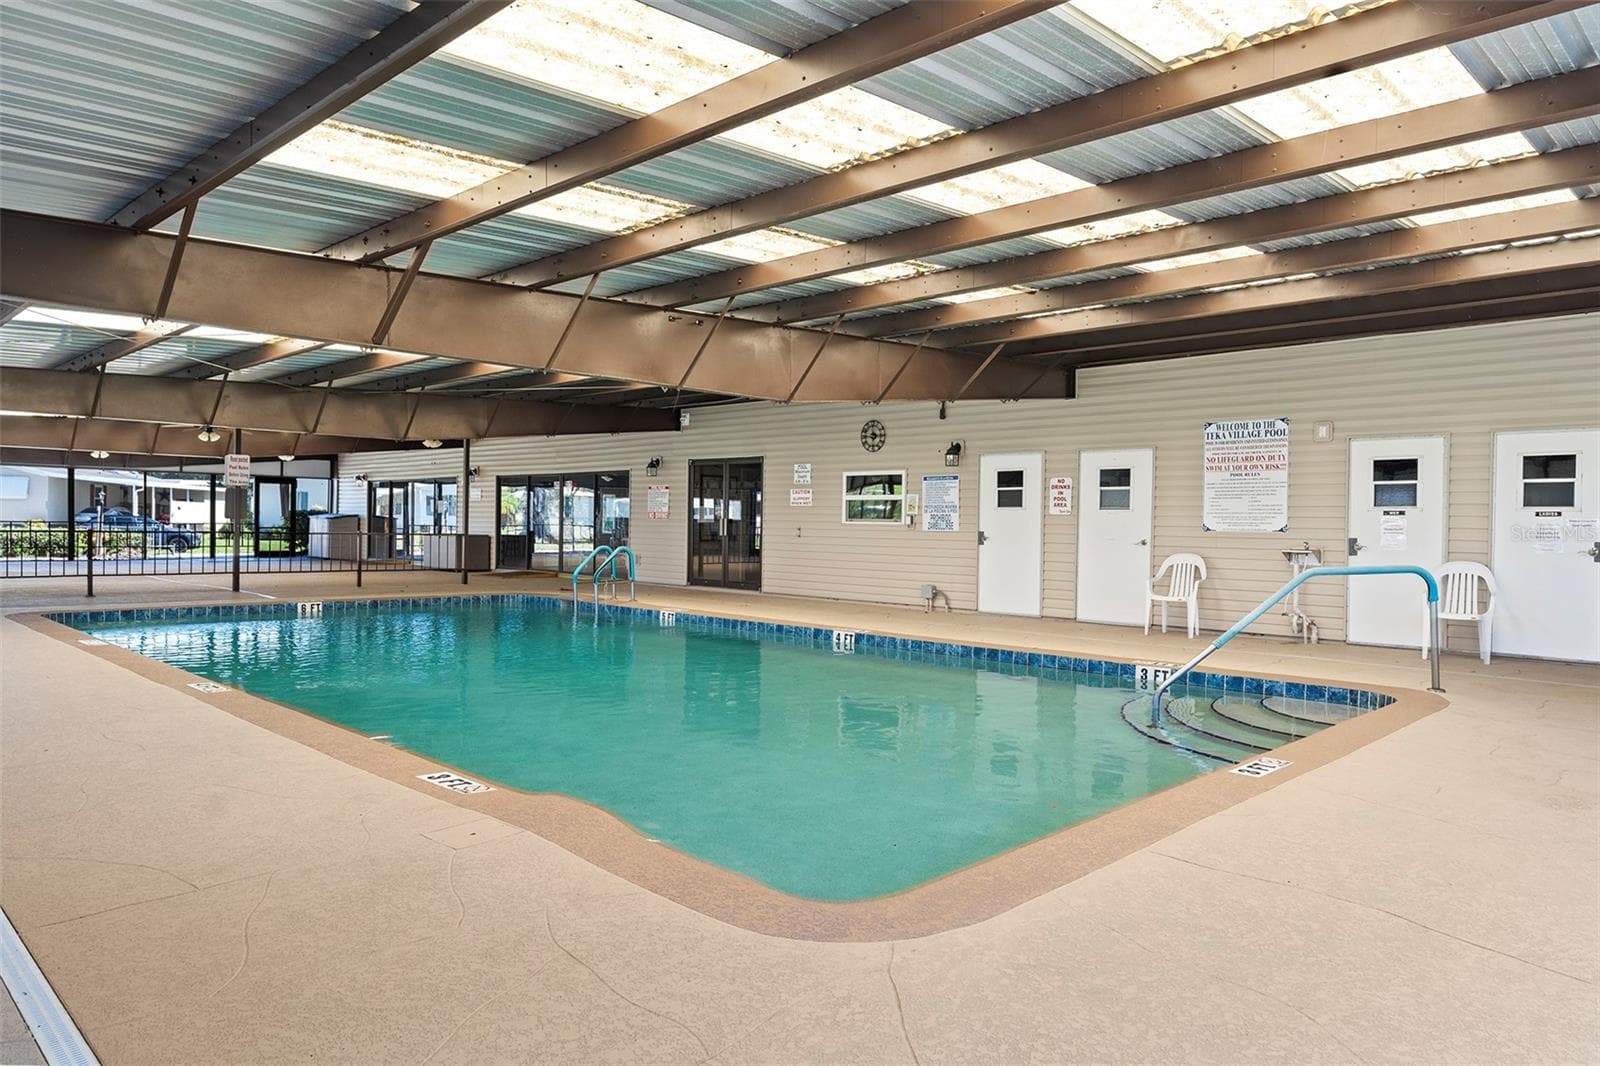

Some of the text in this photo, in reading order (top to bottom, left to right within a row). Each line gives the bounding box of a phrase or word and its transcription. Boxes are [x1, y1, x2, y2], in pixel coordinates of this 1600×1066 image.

[1216, 421, 1276, 431] WELCOME TO THE
[1206, 428, 1287, 440] TEKA VILLAGE POOL
[310, 604, 320, 612] FT
[836, 632, 853, 643] 4 FT
[1141, 668, 1169, 681] 3 FT
